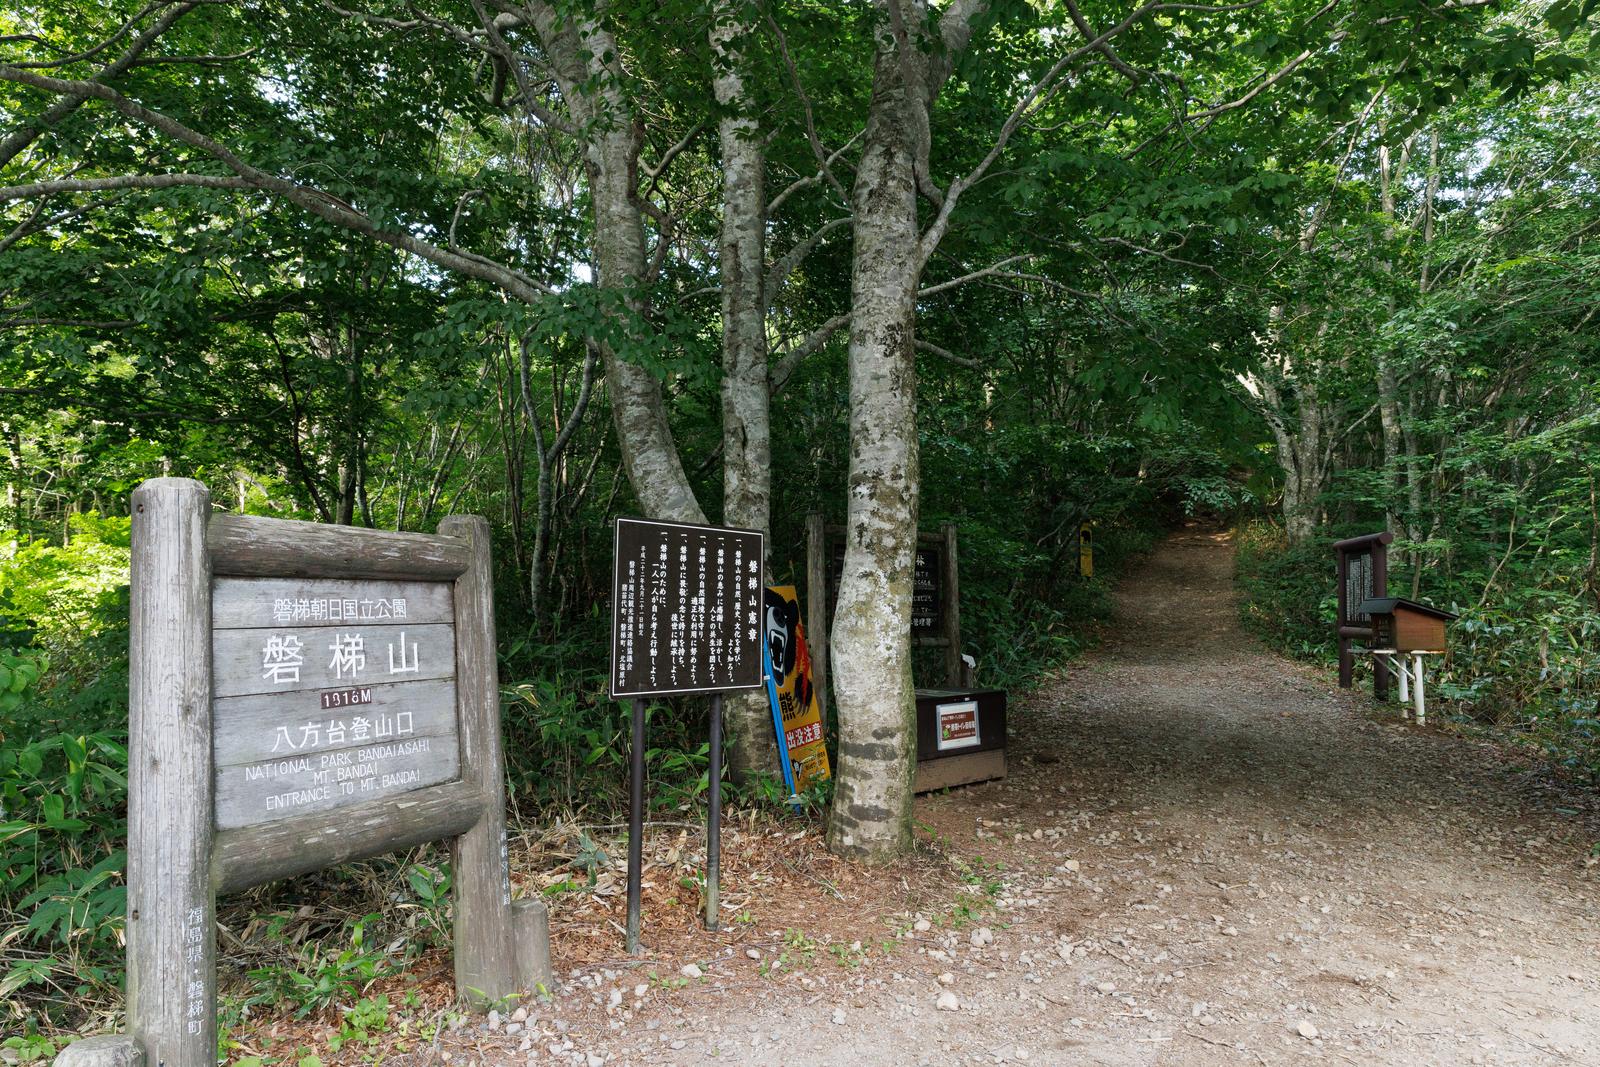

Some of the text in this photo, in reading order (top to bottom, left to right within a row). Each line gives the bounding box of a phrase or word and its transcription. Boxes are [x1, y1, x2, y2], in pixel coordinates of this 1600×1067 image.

[273, 598, 407, 622] 磐梯朝日国立公園
[747, 559, 758, 643] 磐梯山憲章
[262, 631, 420, 684] 磐梯山
[779, 692, 796, 722] 熊
[271, 711, 414, 754] 八方台登山口
[786, 722, 821, 749] 出没注意
[245, 740, 431, 782] NATIONAL PARK BANDAIASAHI
[265, 787, 331, 811] ENTRANCE
[340, 781, 355, 796] TO
[187, 908, 204, 1036] 福島県・磐梯町
